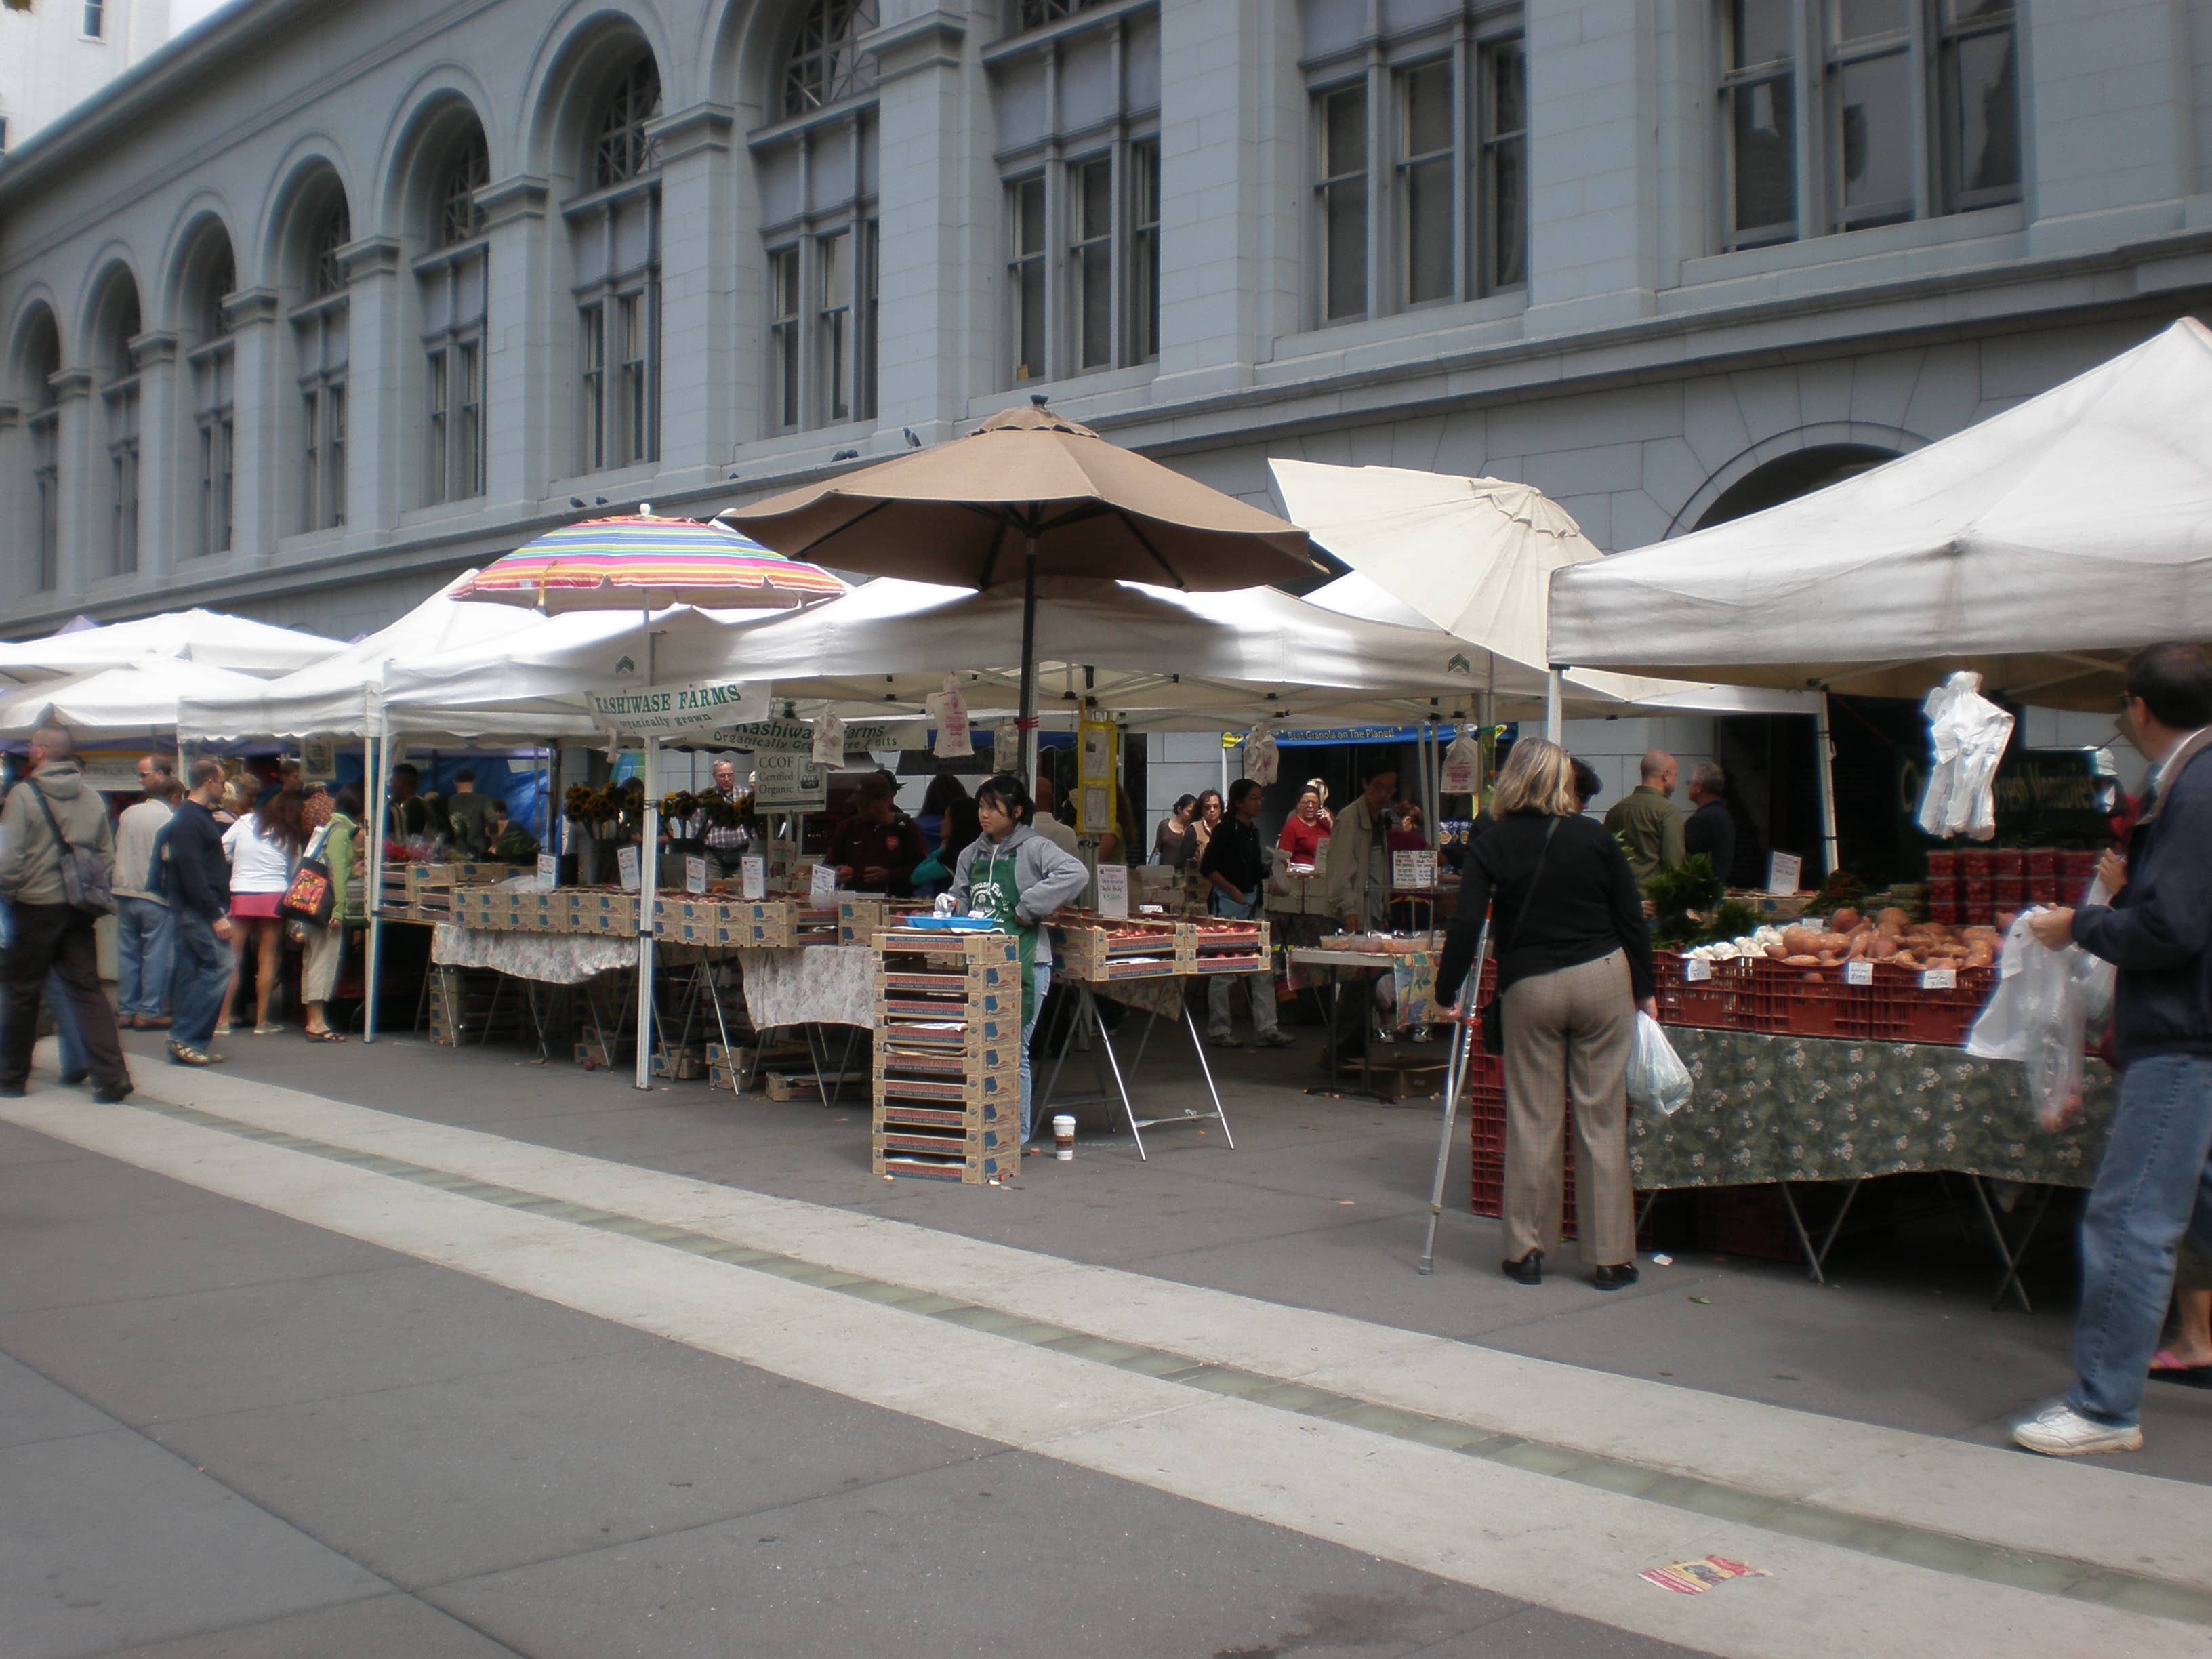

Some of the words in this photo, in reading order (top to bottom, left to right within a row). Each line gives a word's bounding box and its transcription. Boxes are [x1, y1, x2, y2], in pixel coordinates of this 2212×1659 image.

[595, 693, 671, 714] KASHIWASE
[678, 684, 741, 710] FARMS
[675, 714, 712, 726] grown
[735, 722, 813, 739] Kashiwa
[844, 725, 884, 738] arms
[1288, 731, 1304, 741] Best
[1306, 730, 1336, 740] Granola
[1349, 729, 1364, 738] The
[1366, 728, 1395, 738] Planet!
[714, 731, 790, 749] Organically
[759, 757, 794, 769] CCOF
[758, 773, 794, 781] Certified
[758, 785, 794, 796] Organic
